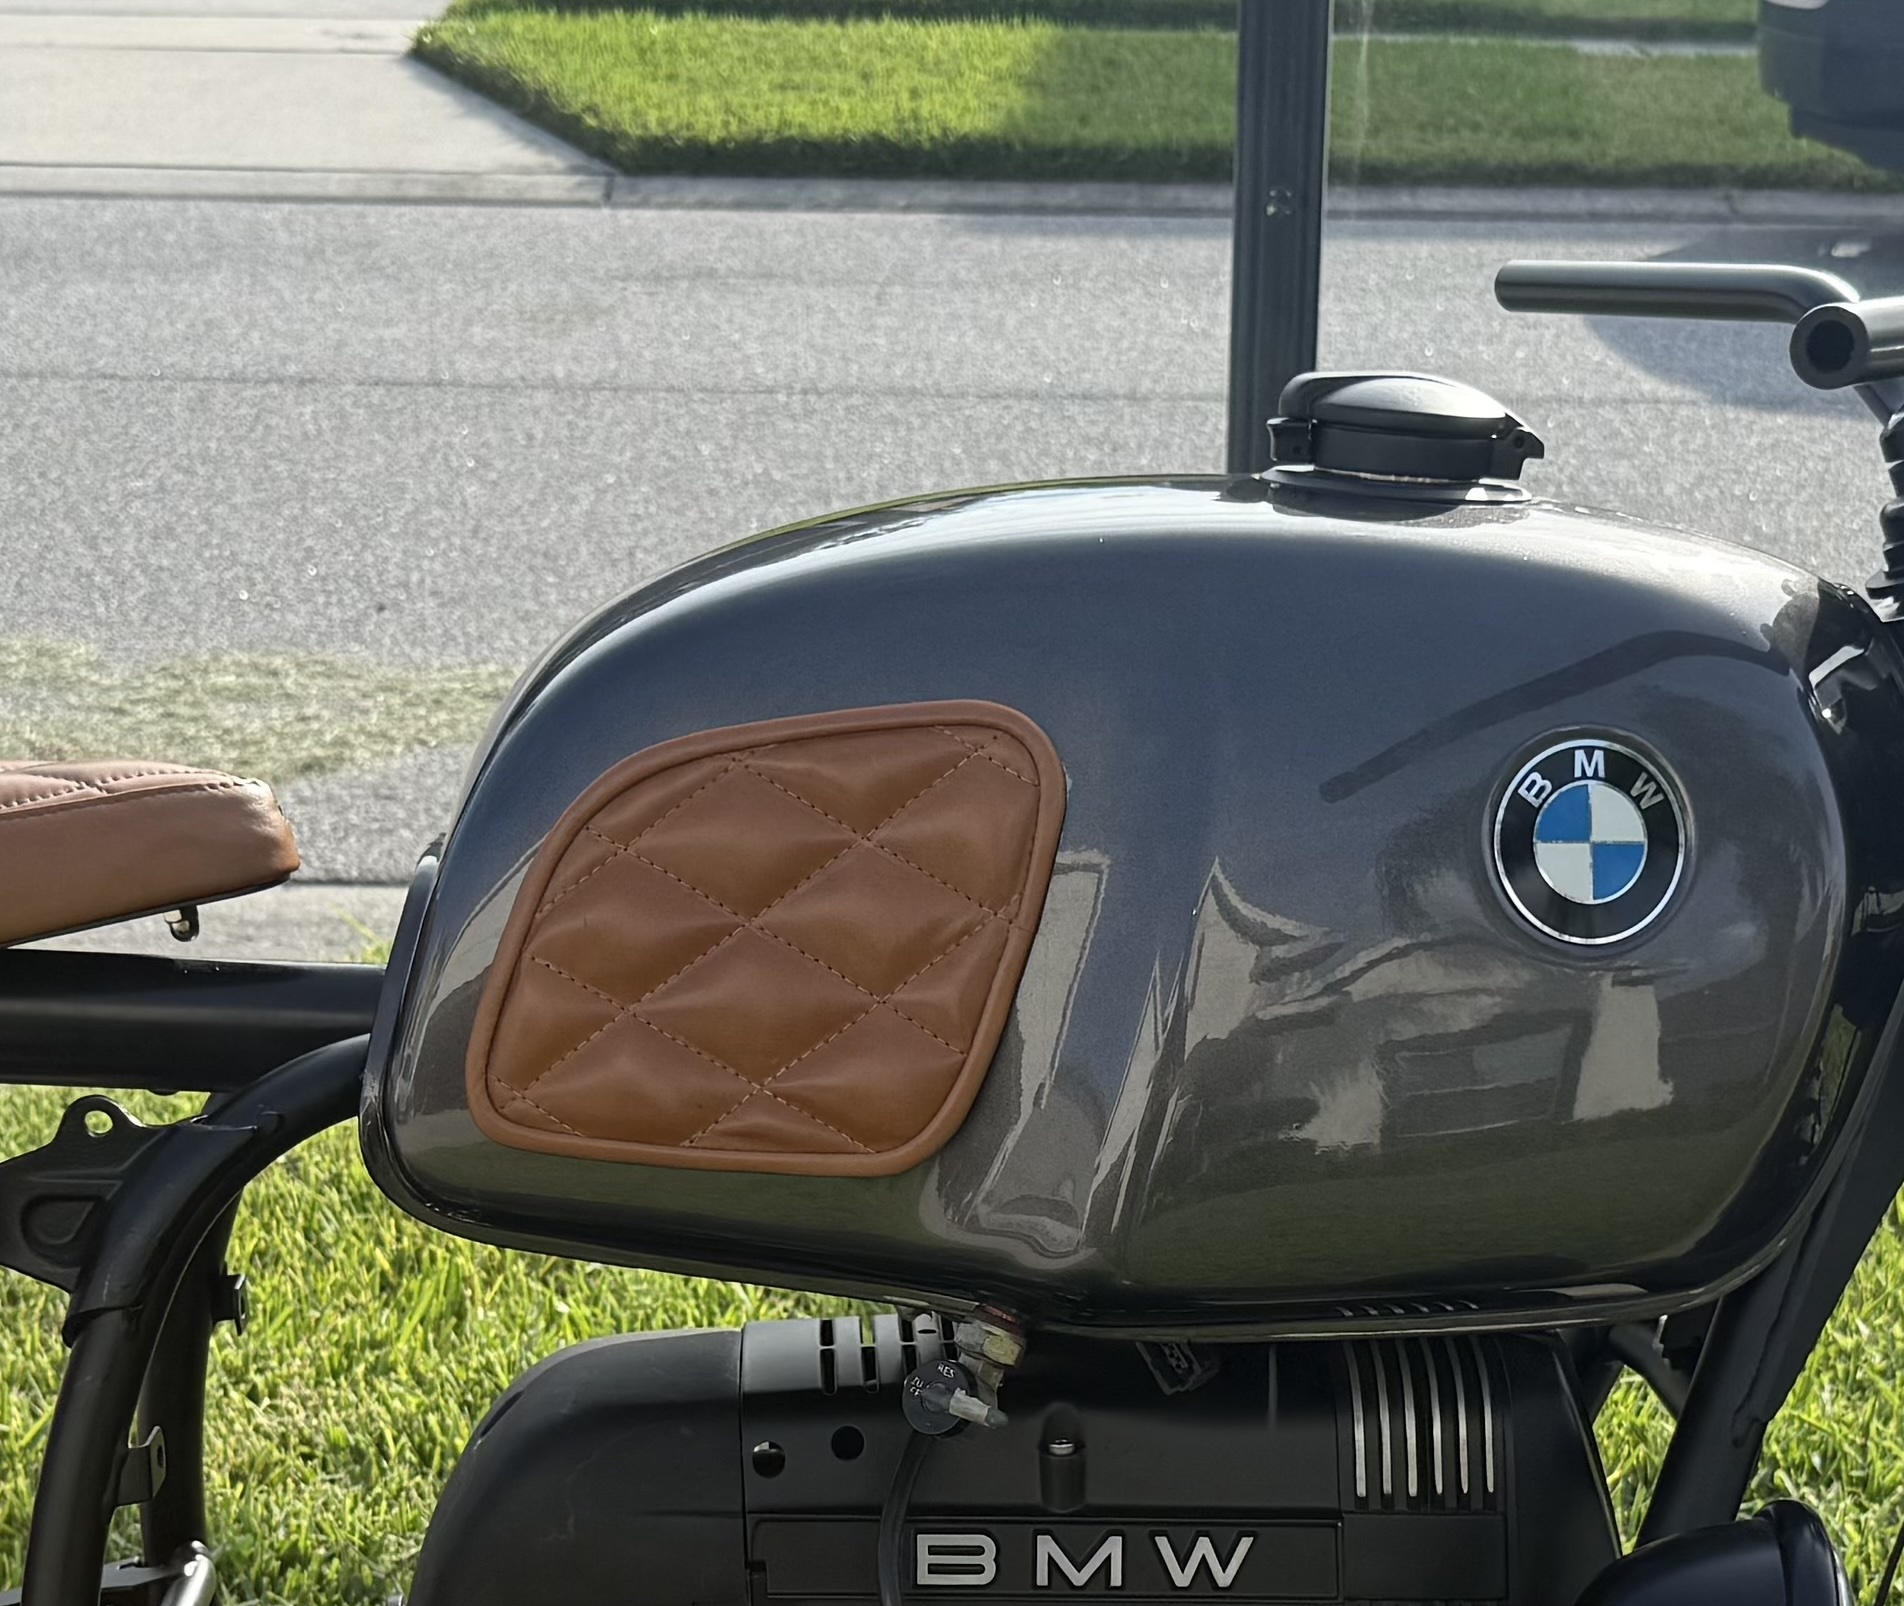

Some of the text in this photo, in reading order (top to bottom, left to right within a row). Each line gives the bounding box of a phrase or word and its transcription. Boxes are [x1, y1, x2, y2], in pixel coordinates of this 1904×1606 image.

[1518, 750, 1664, 810] BMW
[937, 1362, 955, 1378] RES
[917, 1534, 1254, 1587] BMW
